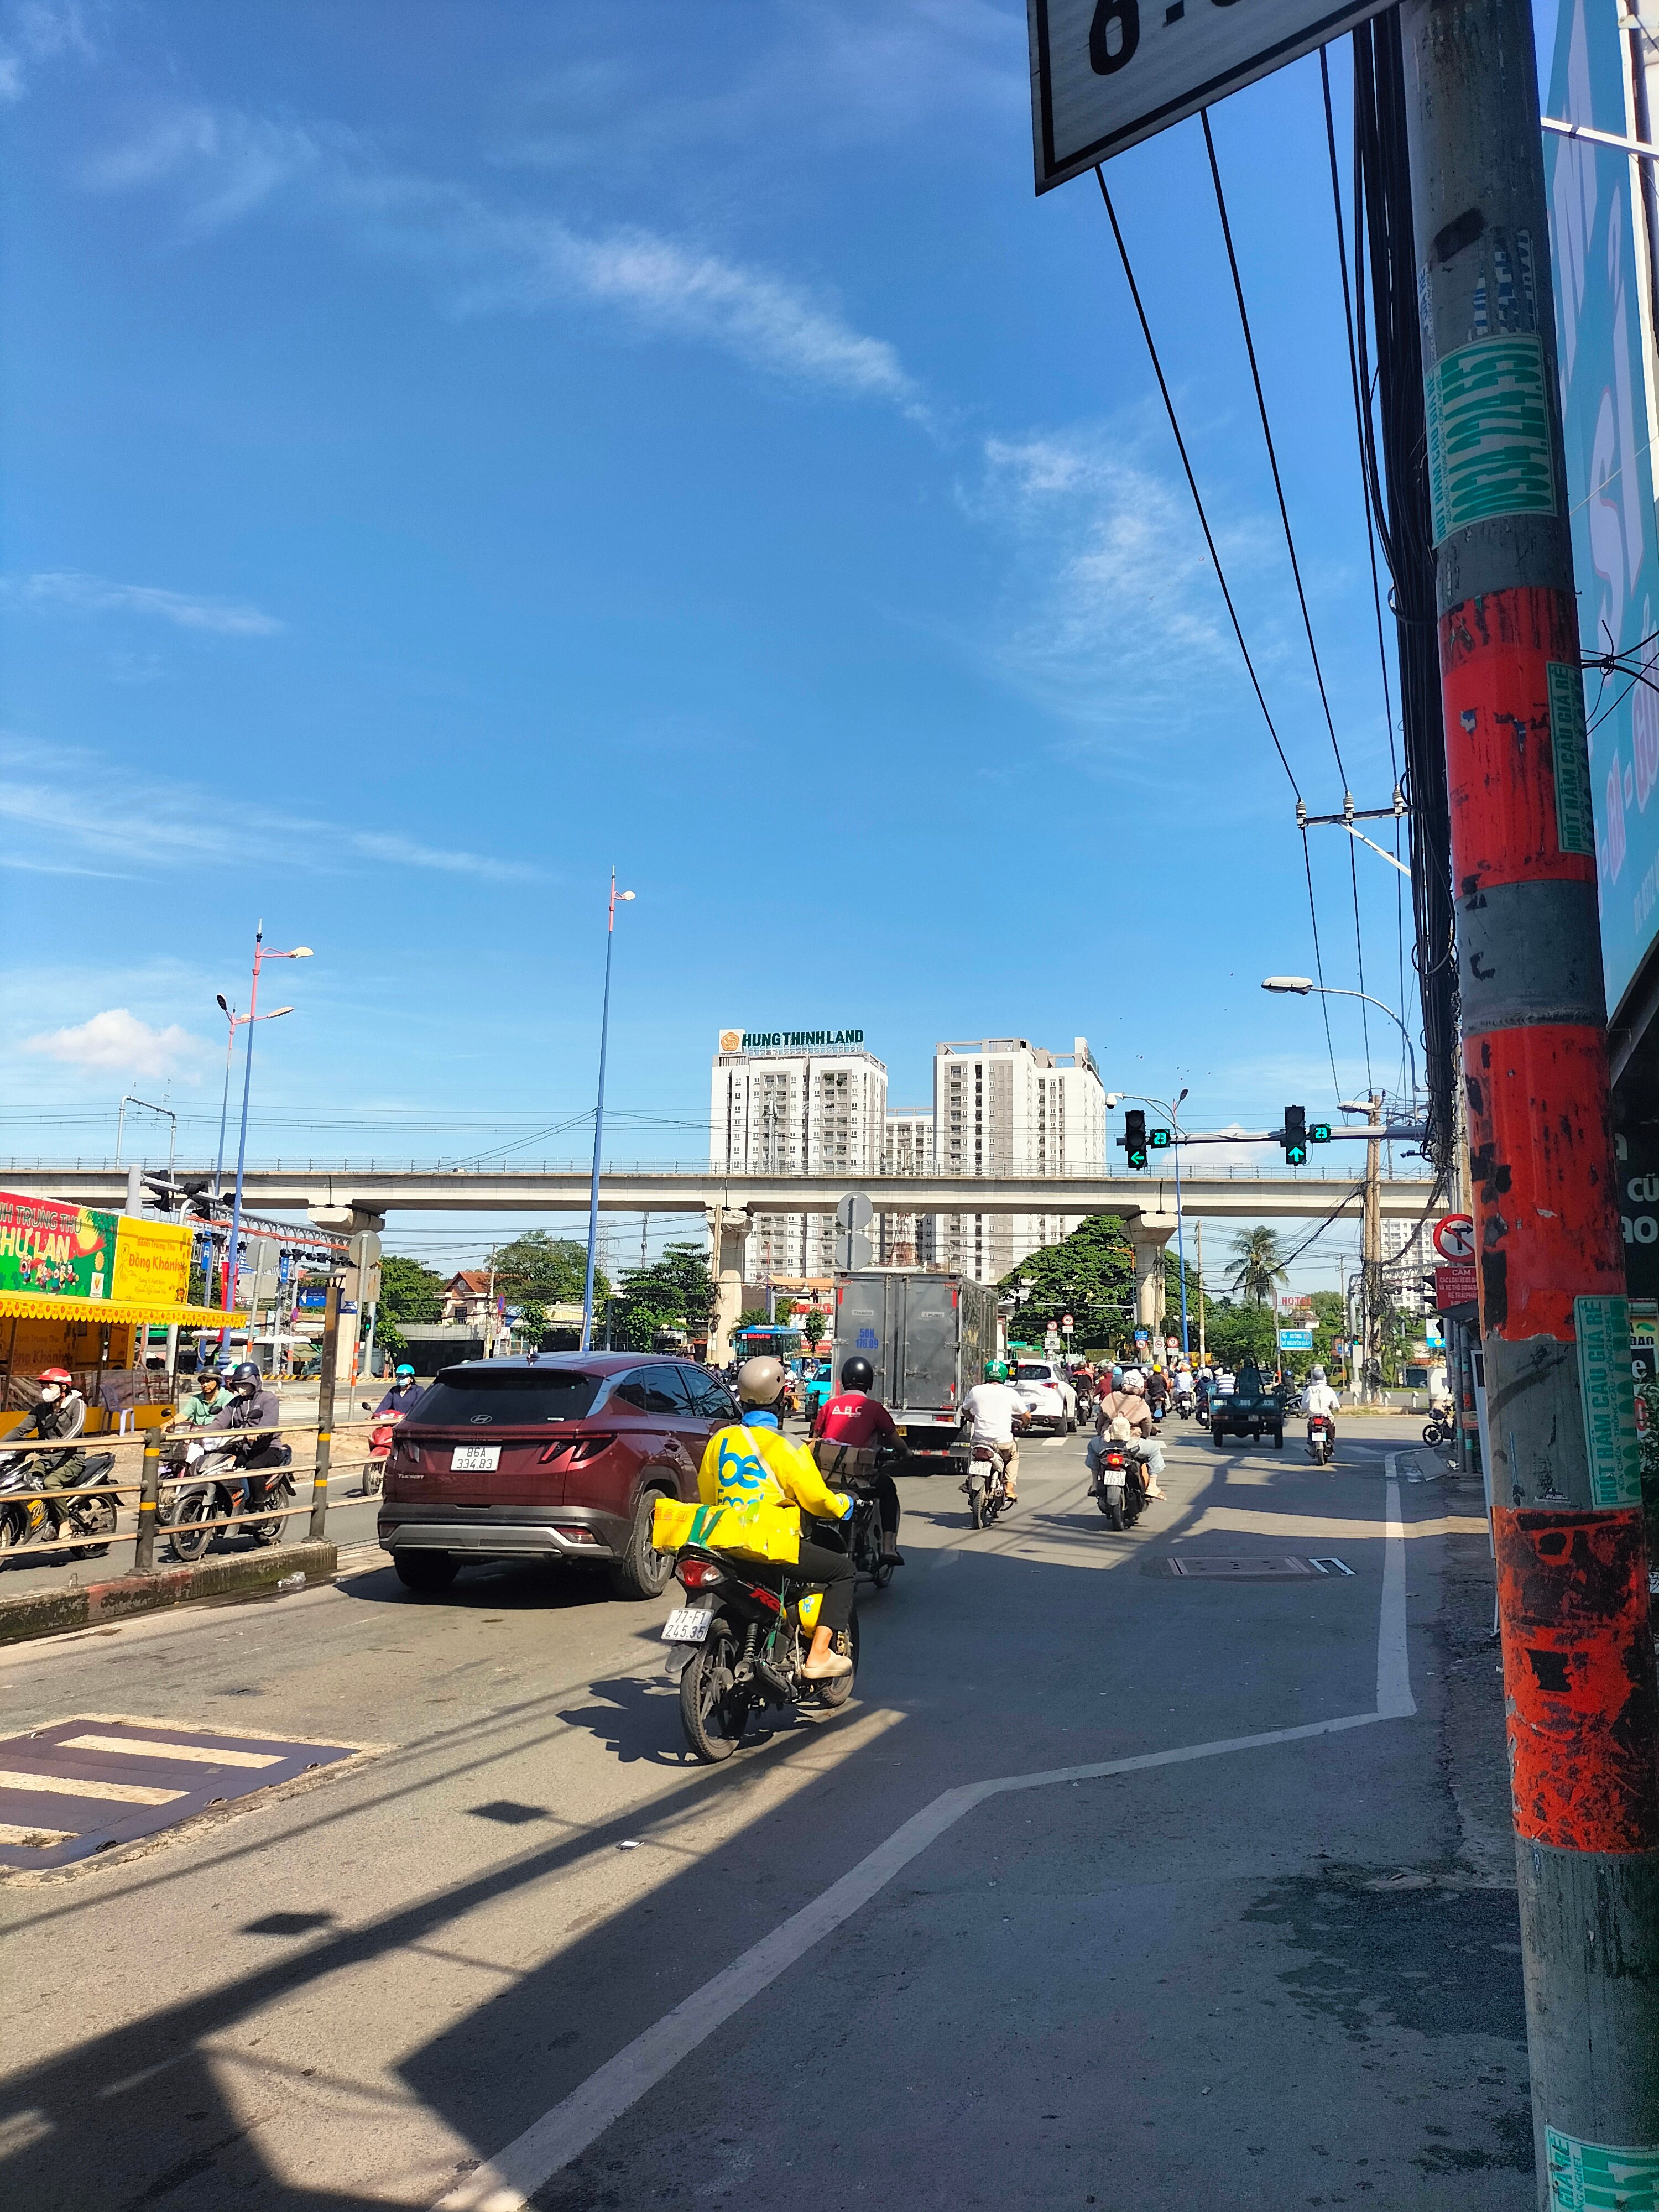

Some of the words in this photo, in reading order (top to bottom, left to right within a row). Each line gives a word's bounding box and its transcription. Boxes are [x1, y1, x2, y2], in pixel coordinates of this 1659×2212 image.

[1553, 695, 1572, 723] GIÁ
[1556, 727, 1575, 764] CẦU
[1560, 768, 1579, 810] HẦM
[1563, 813, 1582, 848] HÚT
[742, 1032, 781, 1047] HUNG
[782, 1031, 825, 1046] THINH
[826, 1029, 864, 1044] LAND
[1154, 1132, 1166, 1145] 23
[1316, 1127, 1328, 1139] 23
[16, 1205, 58, 1230] TRUNG
[60, 1213, 82, 1234] THU
[33, 1231, 71, 1264] LAN
[129, 1251, 150, 1272] Đồng
[152, 1256, 180, 1271] Khánh
[1281, 1297, 1312, 1306] HOTEL
[1580, 1301, 1603, 1326] RẺ
[855, 1338, 879, 1349] 176.09
[859, 1328, 875, 1338] 50H
[1583, 1329, 1605, 1363] GIÁ
[1585, 1368, 1609, 1408] CẦU
[1591, 1413, 1614, 1459] HẦM
[456, 1458, 493, 1469] 334.83
[467, 1447, 486, 1458] 86A
[718, 1438, 768, 1489] be
[1596, 1465, 1618, 1502] HÚT
[665, 1624, 707, 1639] 245.35
